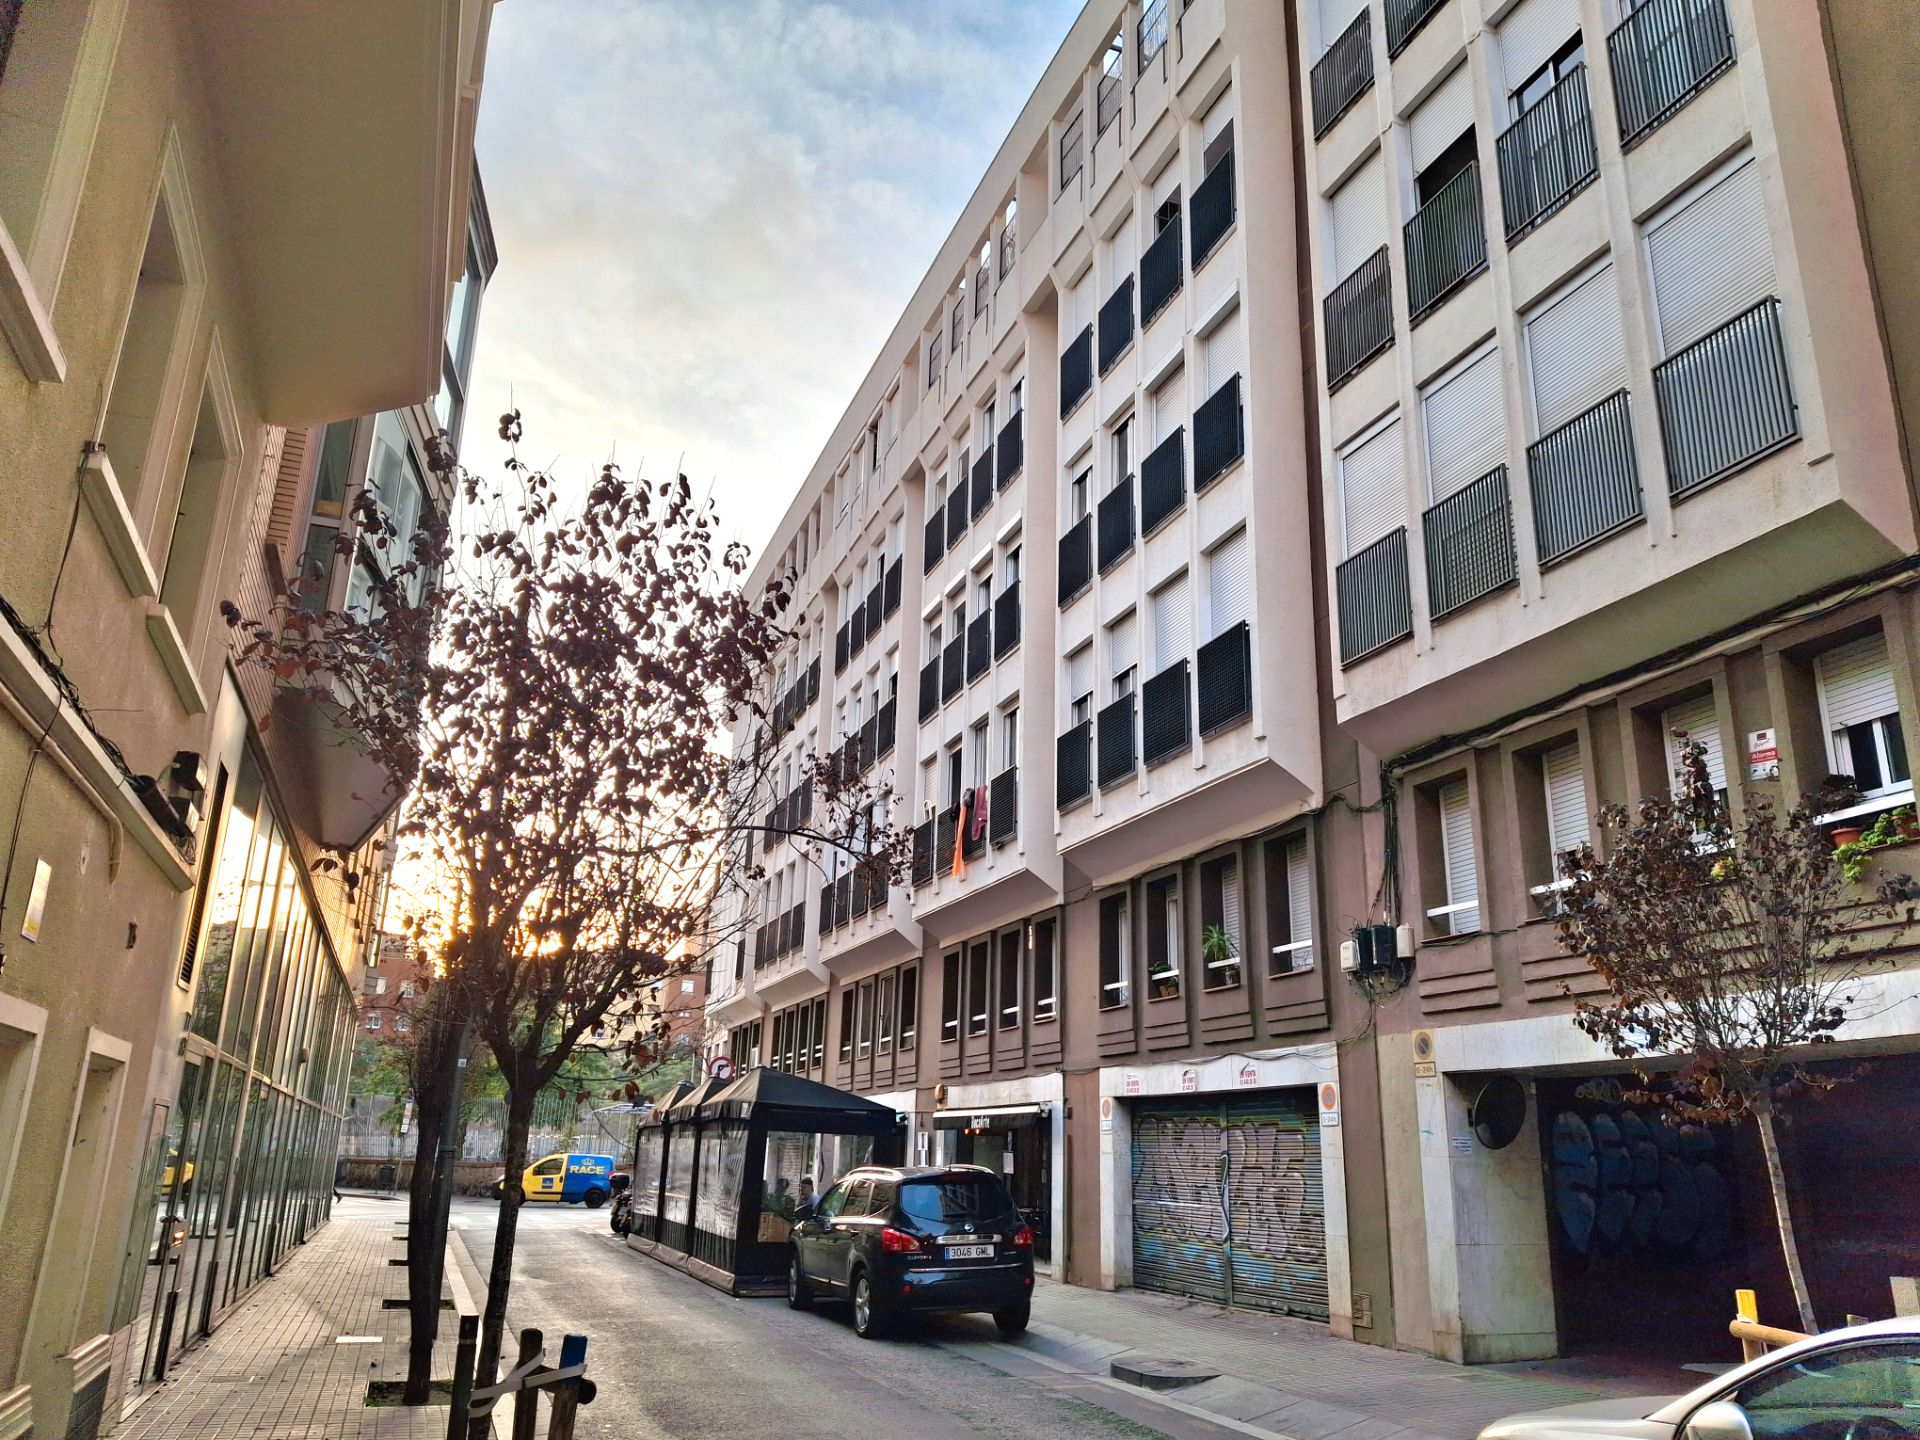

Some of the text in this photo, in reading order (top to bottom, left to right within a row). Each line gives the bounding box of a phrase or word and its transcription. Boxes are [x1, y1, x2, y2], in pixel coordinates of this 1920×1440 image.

[1752, 750, 1776, 760] Alarma
[570, 1165, 605, 1175] RACE
[951, 1246, 991, 1258] 3046 GML
